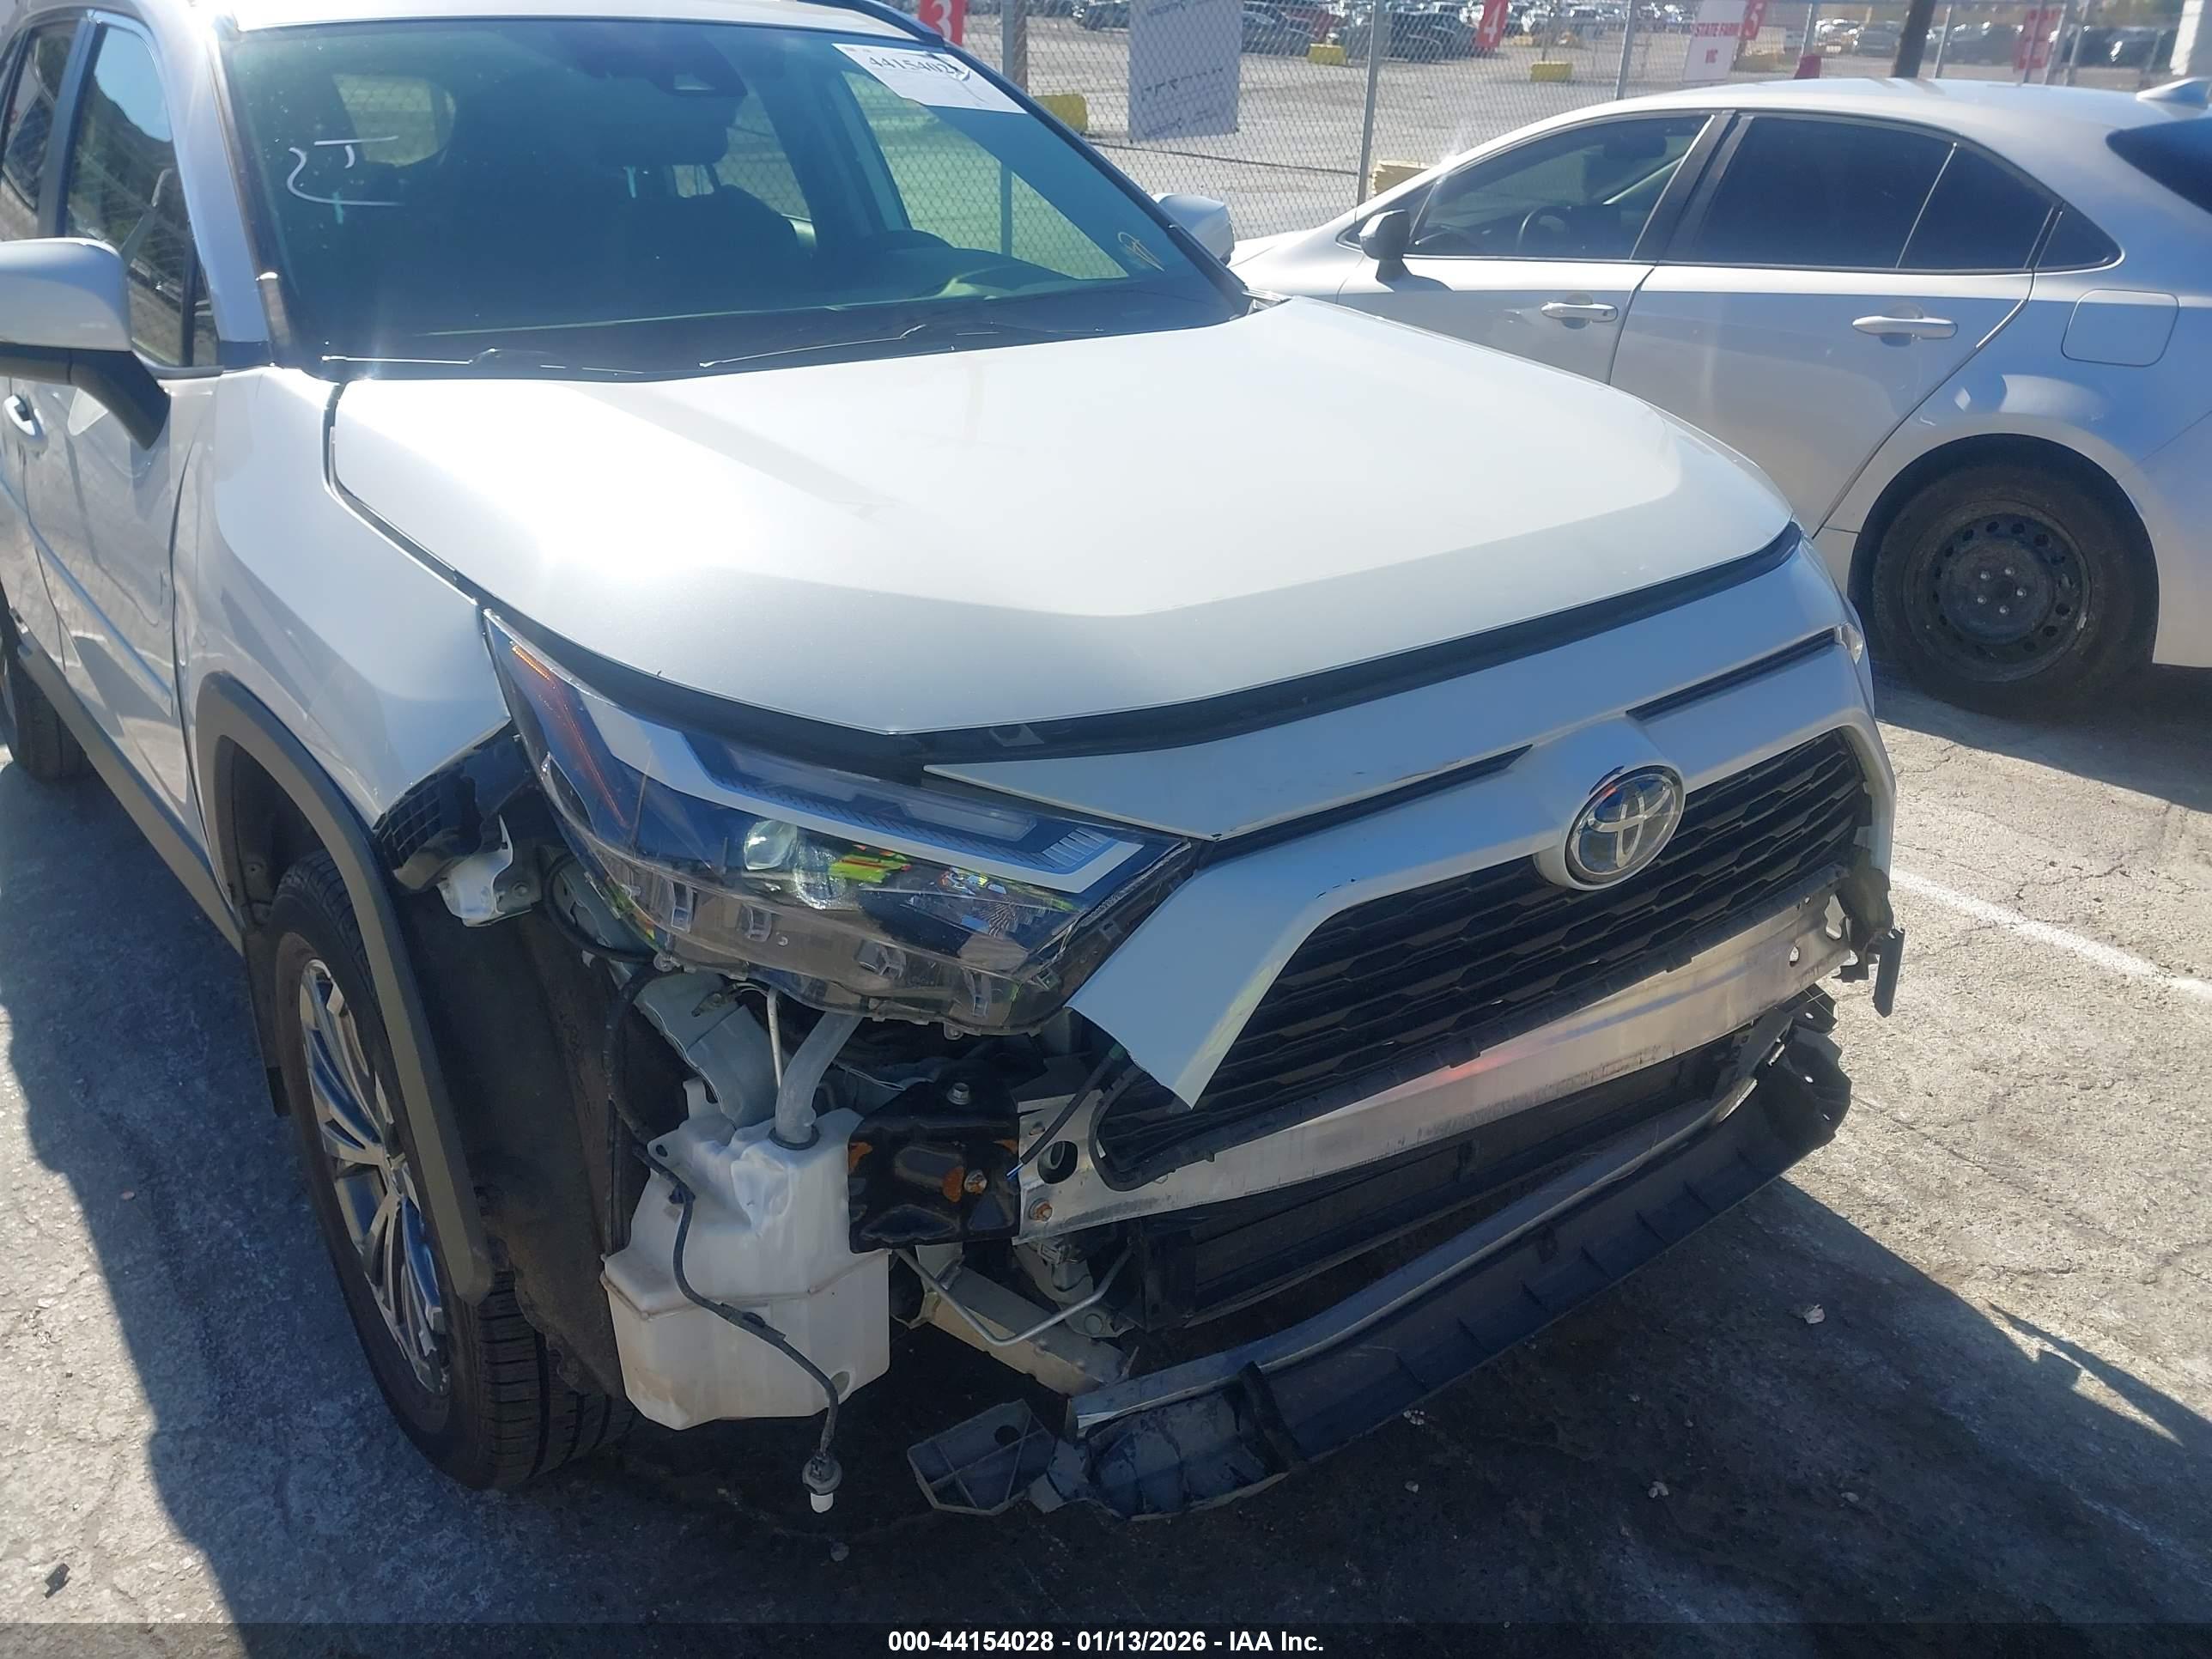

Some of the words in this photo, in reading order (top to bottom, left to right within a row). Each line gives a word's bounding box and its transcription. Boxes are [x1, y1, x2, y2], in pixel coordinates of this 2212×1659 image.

[930, 0, 952, 40] 3
[1483, 1, 1504, 43] 4
[1694, 22, 1720, 37] STATE
